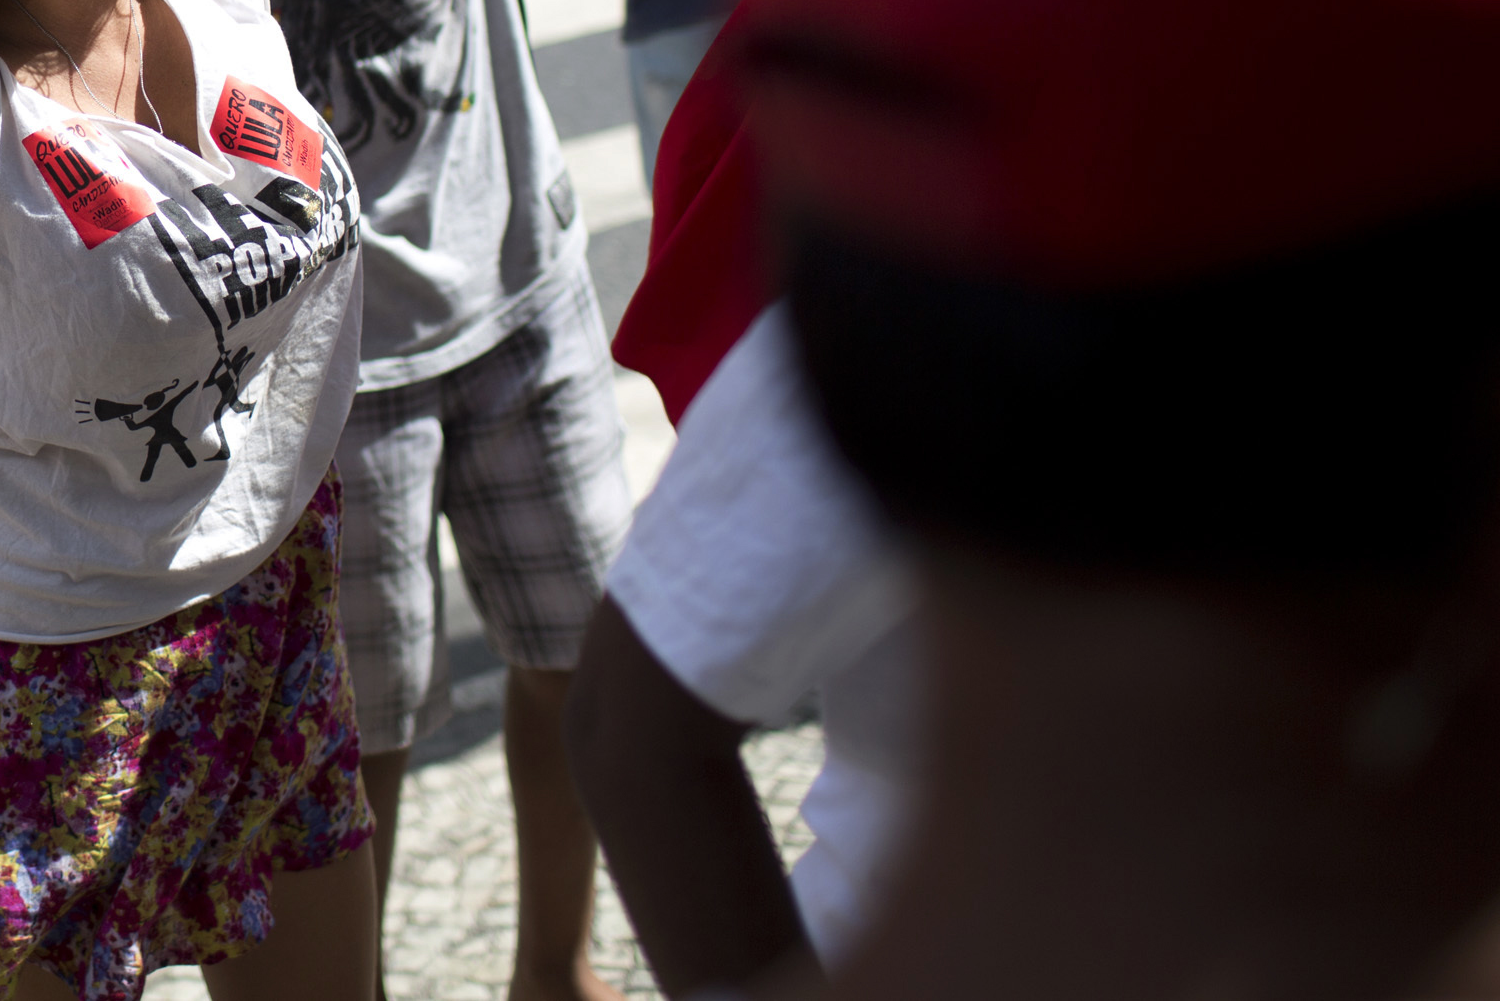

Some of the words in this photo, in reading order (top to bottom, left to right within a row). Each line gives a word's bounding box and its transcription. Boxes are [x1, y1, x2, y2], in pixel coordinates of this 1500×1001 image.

[219, 88, 247, 150] QUERO
[237, 98, 284, 161] LULA
[95, 197, 127, 220] Wadih
